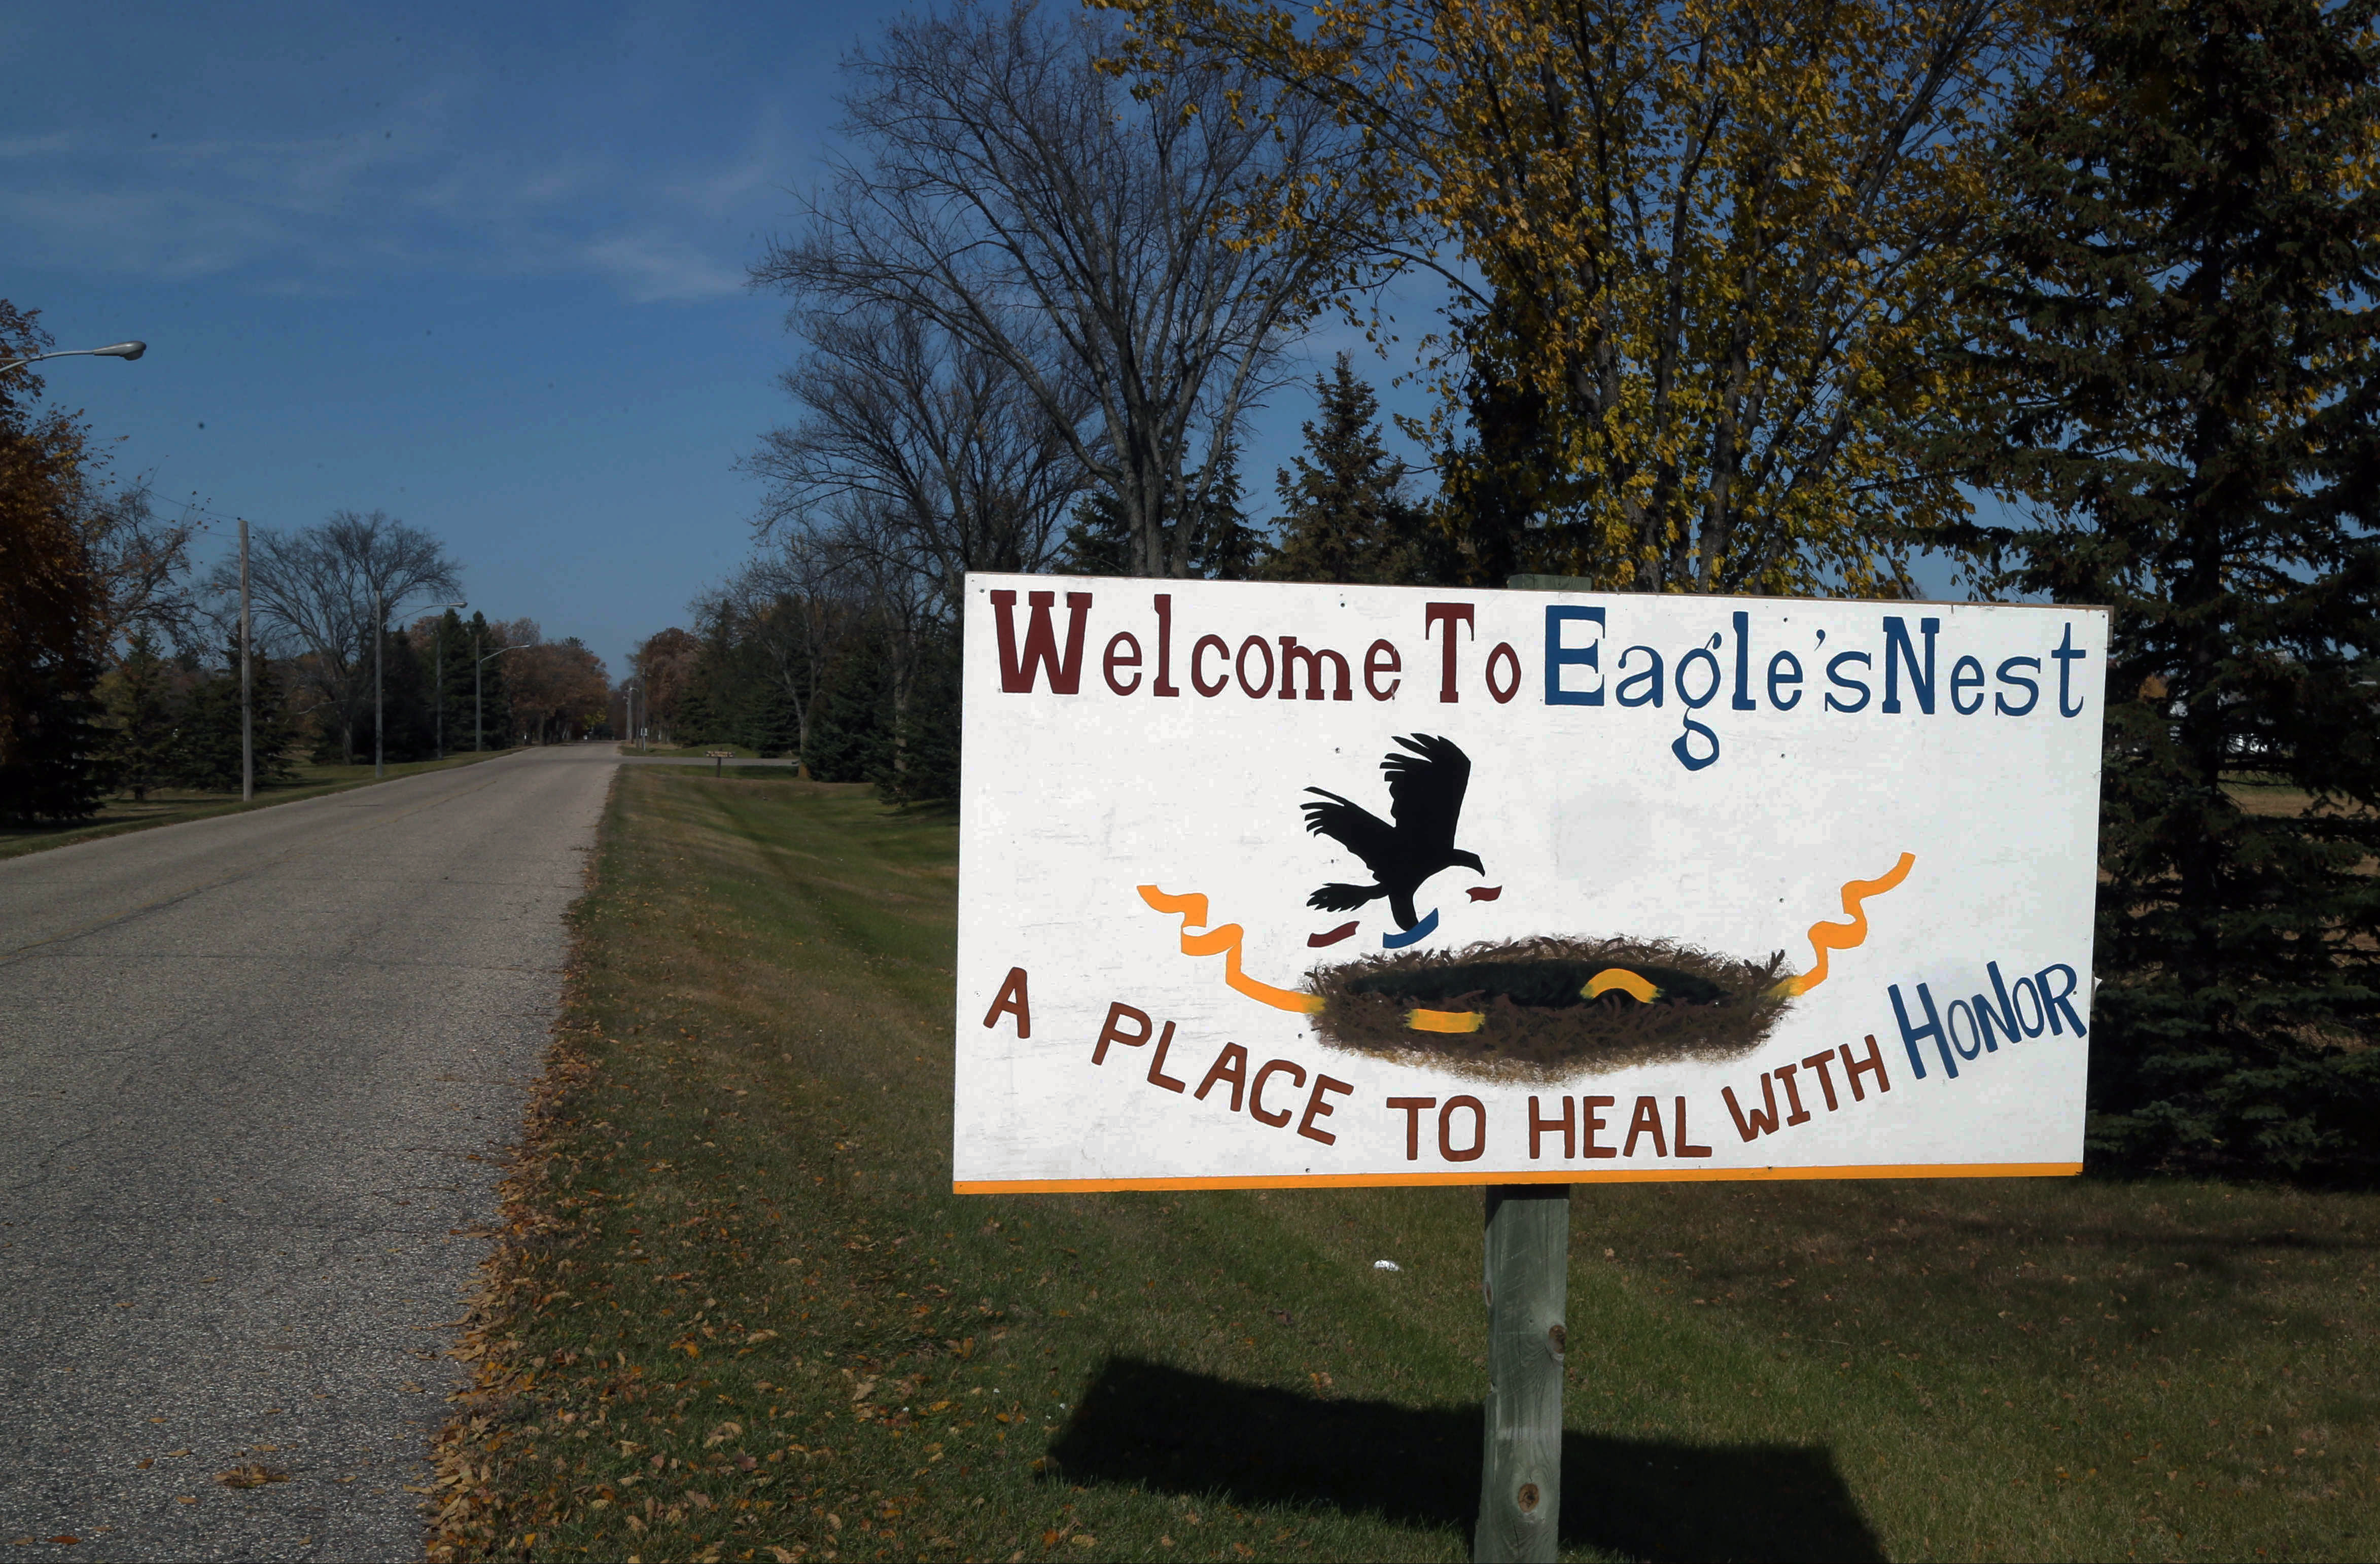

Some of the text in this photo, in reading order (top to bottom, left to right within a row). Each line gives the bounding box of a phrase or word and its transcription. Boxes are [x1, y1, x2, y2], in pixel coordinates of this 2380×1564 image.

[990, 590, 1402, 701] Welcome
[1425, 602, 1521, 704] To
[1882, 616, 2087, 718] Nest
[983, 961, 2088, 1162] A PLACE TO HEAL WITH HONOR
